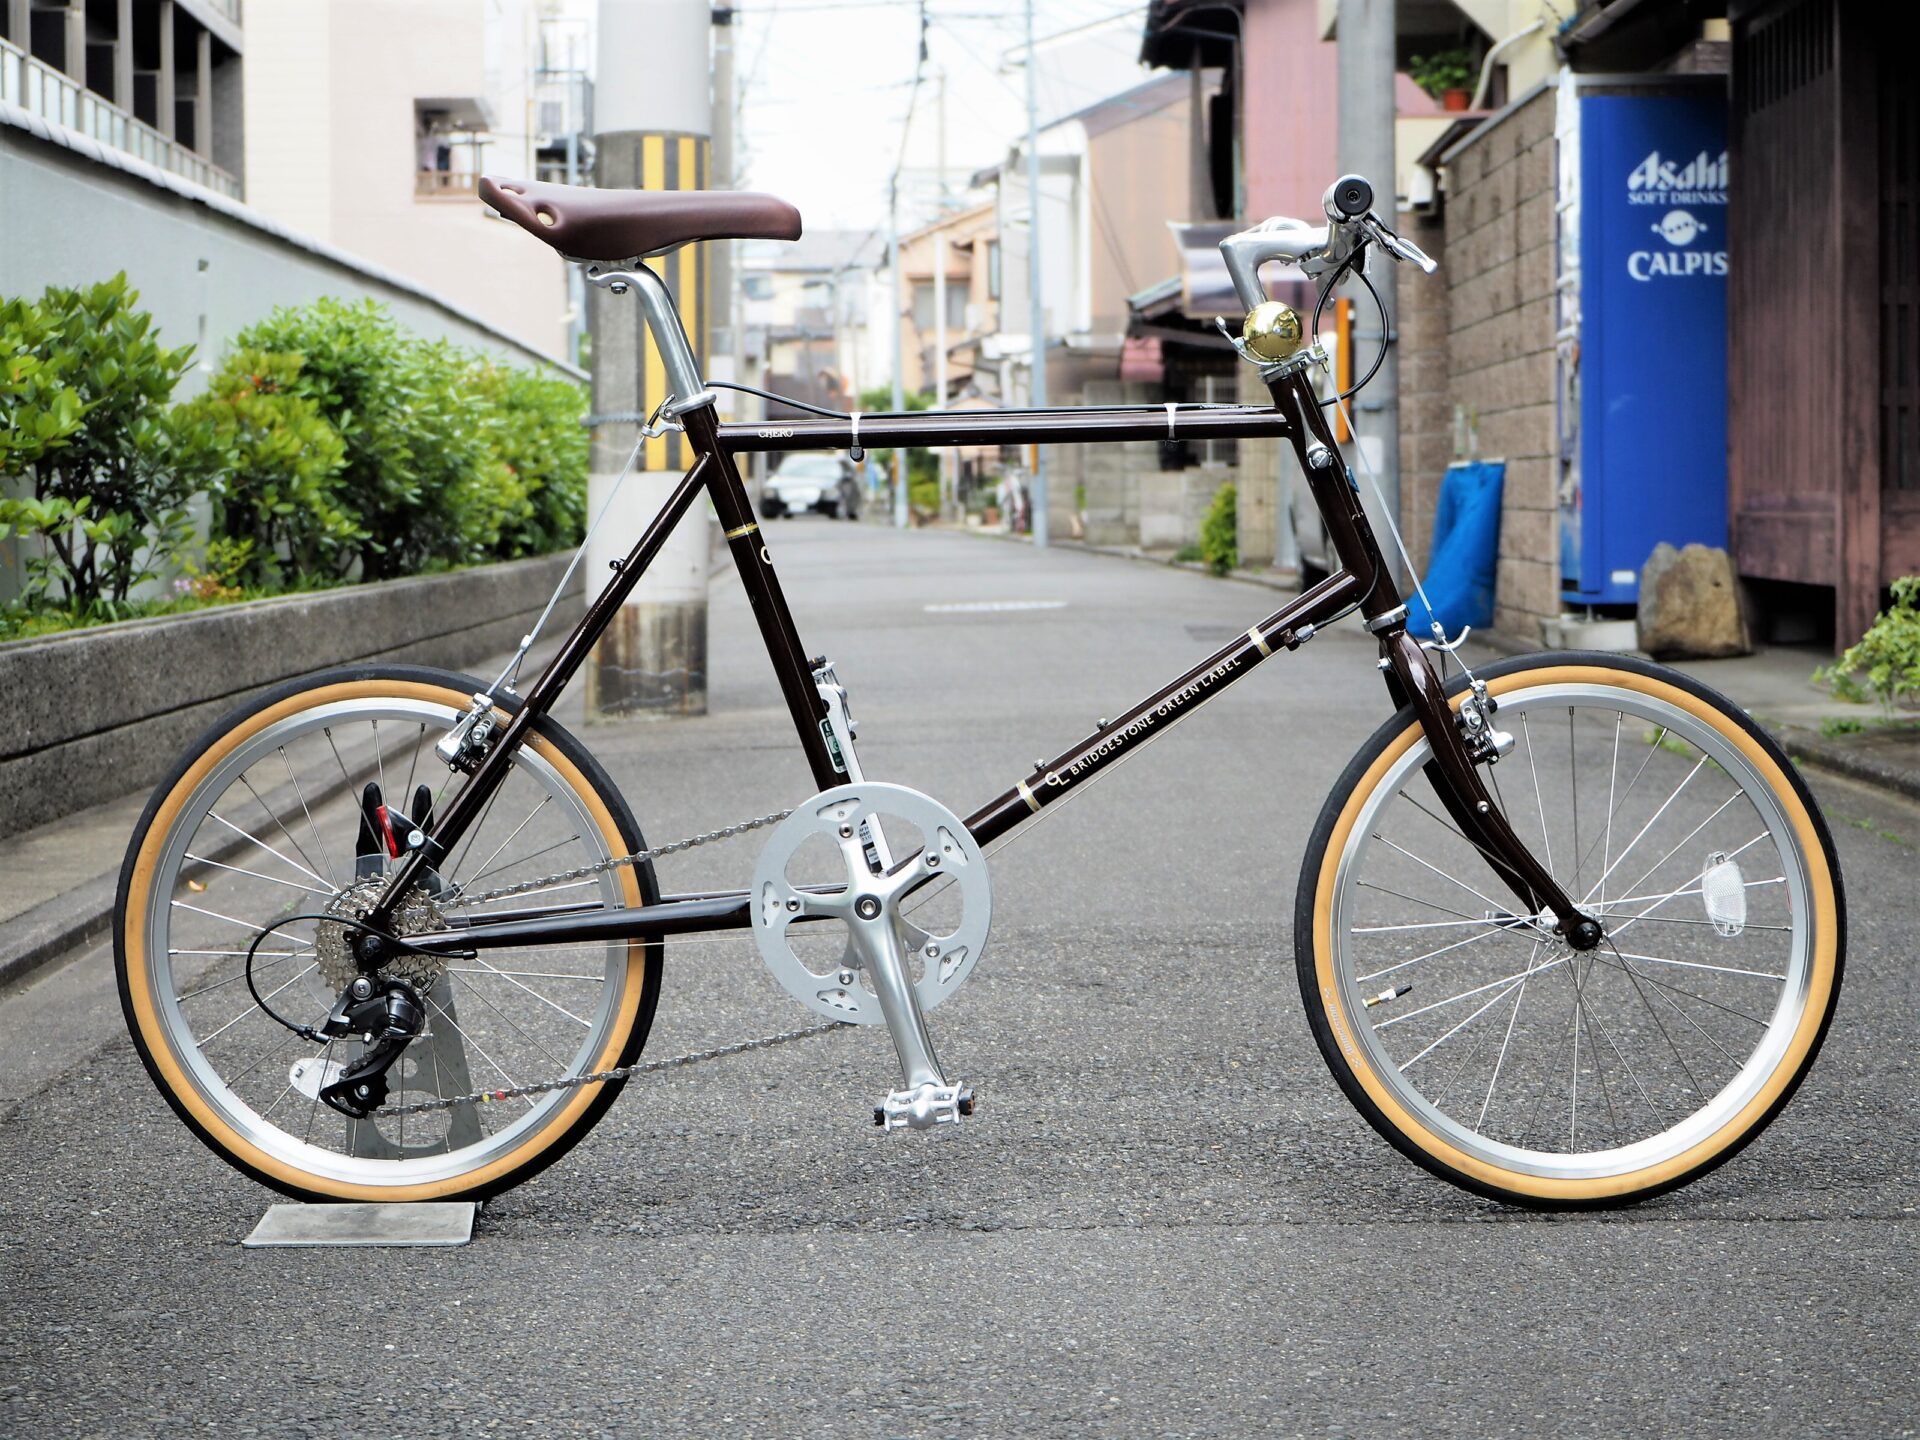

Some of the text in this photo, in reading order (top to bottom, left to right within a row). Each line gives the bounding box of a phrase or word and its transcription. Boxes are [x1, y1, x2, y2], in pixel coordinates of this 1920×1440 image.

[1627, 150, 1729, 190] Asahi
[1627, 191, 1729, 205] SOFT DRINKS
[1627, 251, 1730, 281] CALPIS
[758, 428, 794, 438] CHERO
[1069, 715, 1155, 776] BRIDGESTONE
[1157, 683, 1200, 716] GREEN
[1200, 658, 1241, 687] LABEL
